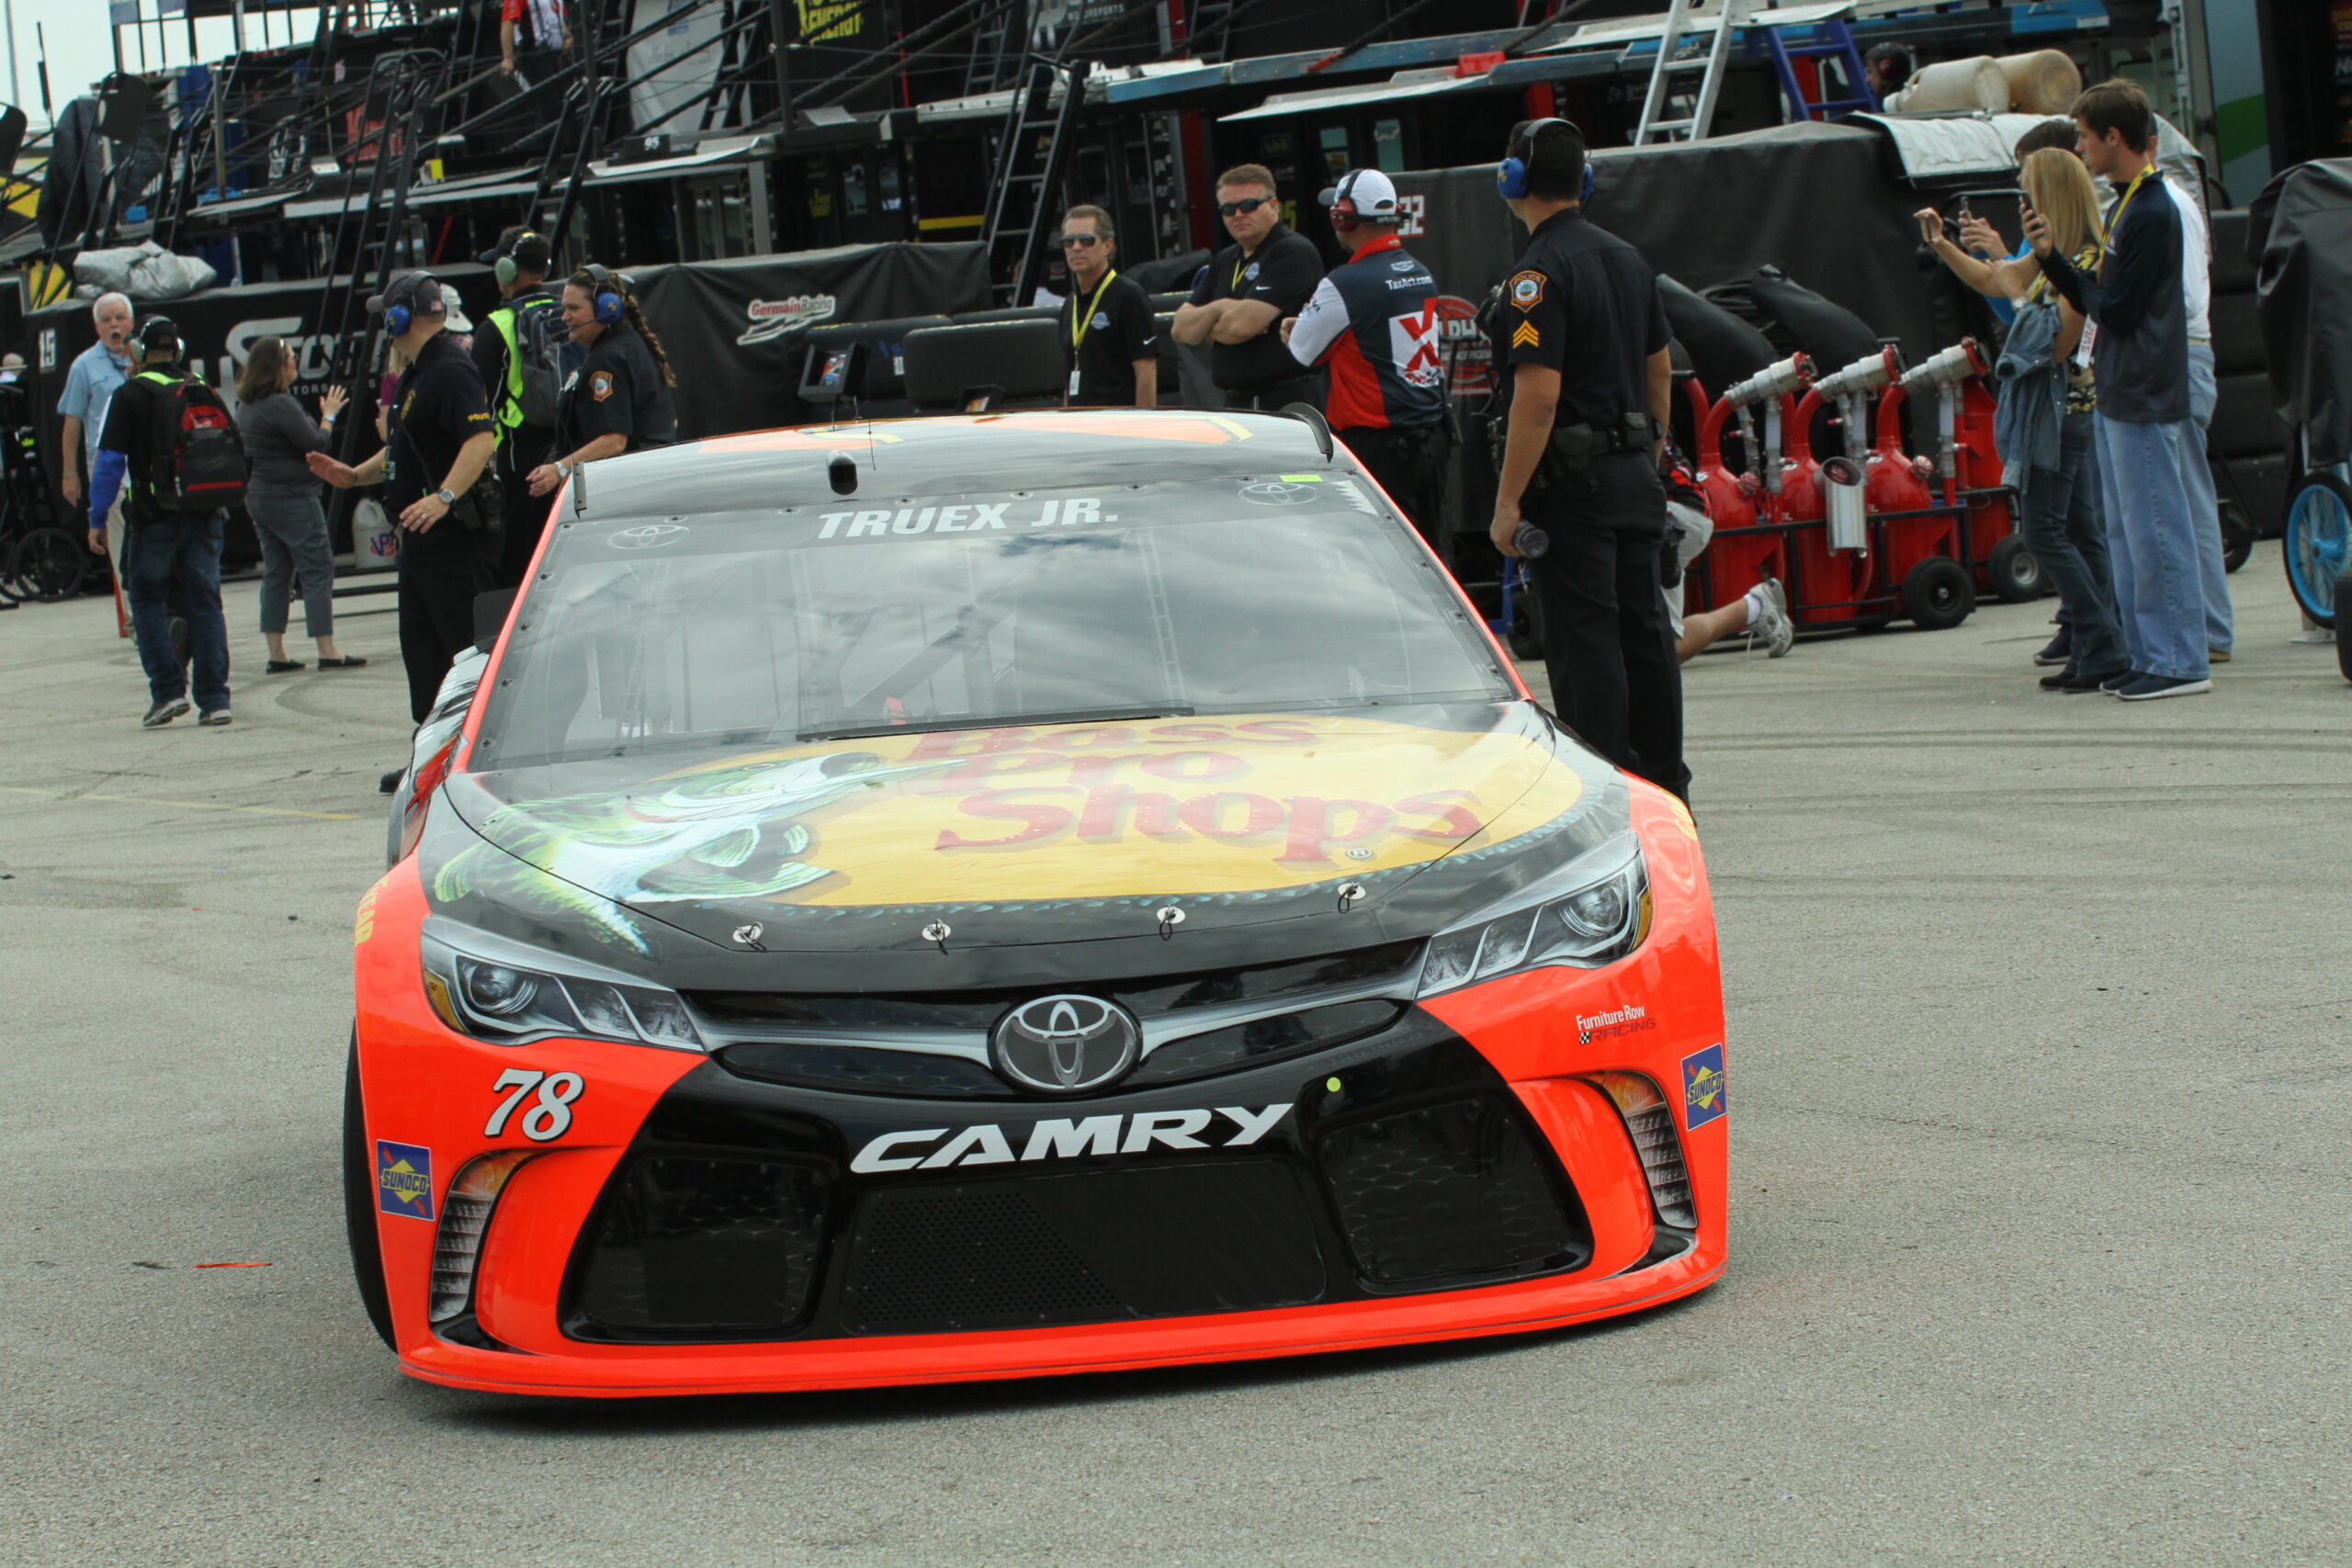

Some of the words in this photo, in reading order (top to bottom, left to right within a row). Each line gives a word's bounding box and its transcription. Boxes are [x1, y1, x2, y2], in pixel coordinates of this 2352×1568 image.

[1385, 276, 1433, 290] TaxAct.com
[1514, 274, 1542, 286] POLICE
[39, 329, 56, 368] 15
[819, 502, 1012, 539] TRUEX
[1030, 497, 1118, 527] JR.
[902, 720, 1323, 761] Bass
[918, 750, 1253, 796] Pro
[934, 784, 1490, 868] Shops
[1575, 1010, 1625, 1032] Furniture
[1623, 1004, 1645, 1020] Row
[1589, 1018, 1657, 1042] RACING
[483, 1066, 585, 1142] 78
[1688, 1074, 1722, 1104] SUNOCO
[849, 1102, 1294, 1175] CAMRY
[381, 1170, 428, 1195] SUNOCO
